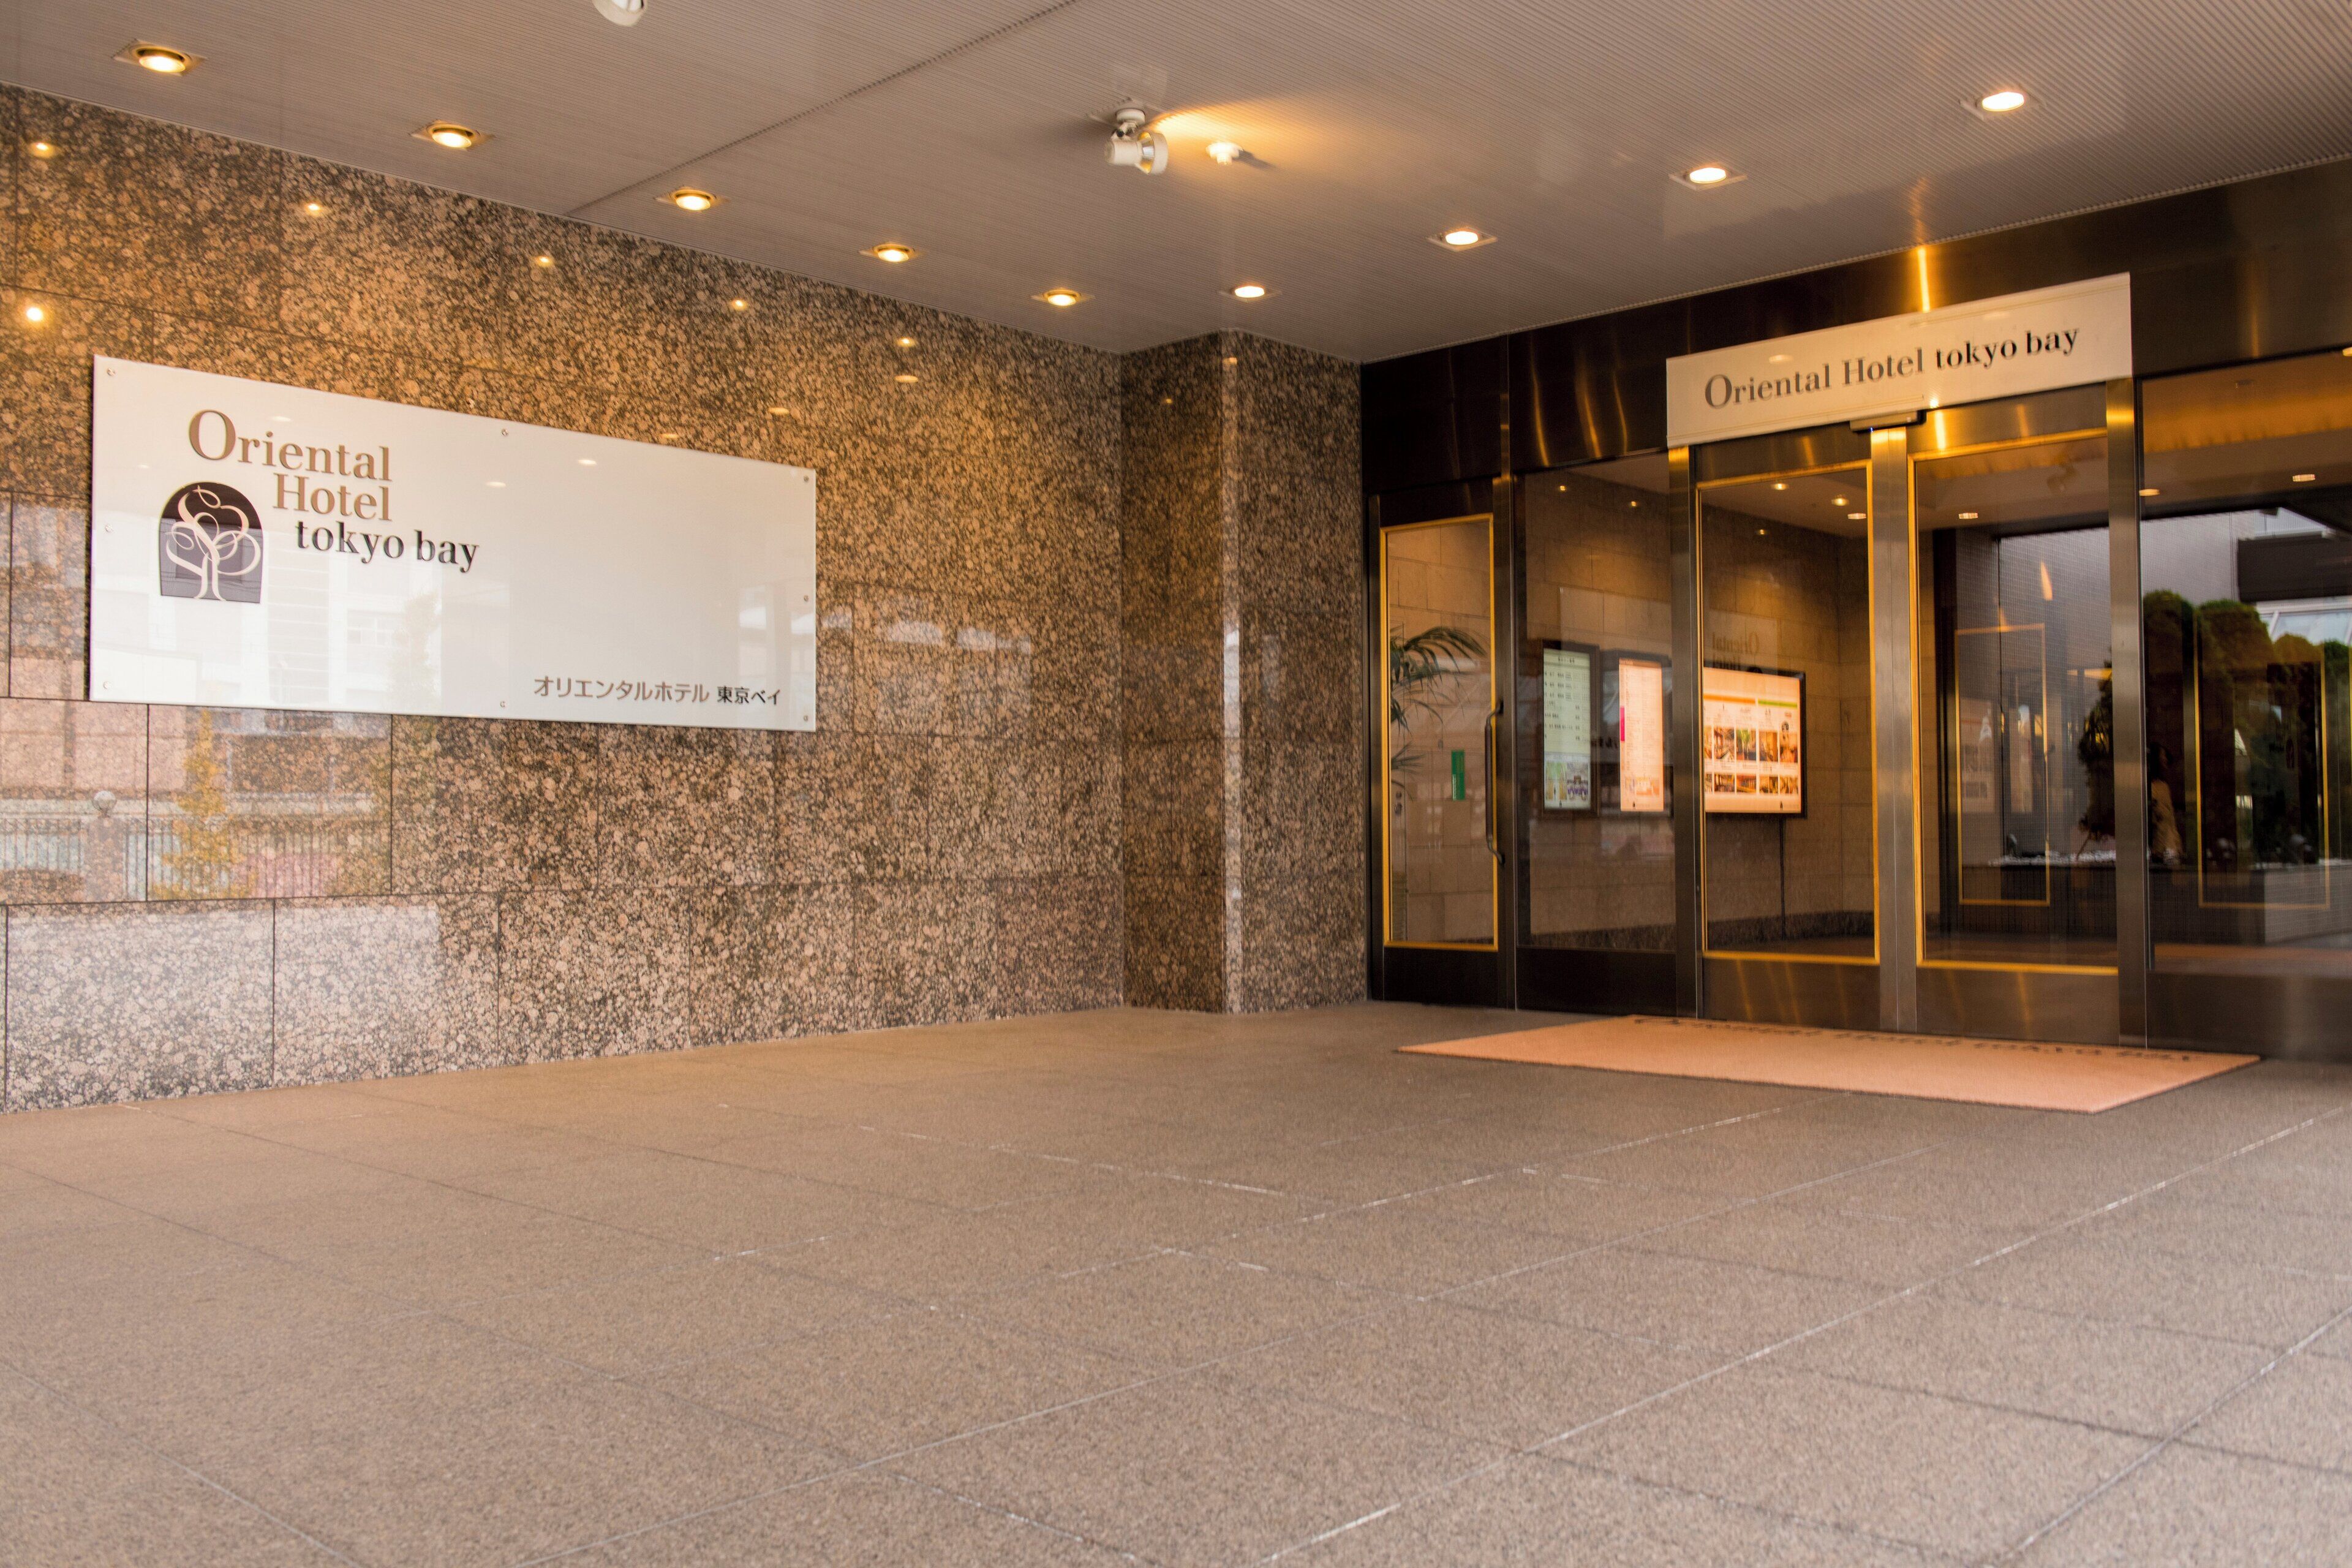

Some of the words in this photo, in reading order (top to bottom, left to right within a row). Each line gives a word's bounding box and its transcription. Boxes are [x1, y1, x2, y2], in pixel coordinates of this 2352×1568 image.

[1705, 364, 1831, 409] Oriental
[1843, 348, 1924, 386] Hotel
[1936, 341, 2018, 369] tokyo
[2026, 328, 2080, 356] bay
[189, 409, 392, 481] Oriental
[273, 473, 392, 521] Hotel
[295, 521, 404, 564] tokyo
[415, 530, 480, 573] bay
[534, 676, 710, 703] オリエンタルホテル
[717, 685, 782, 705] 東京ベイ
